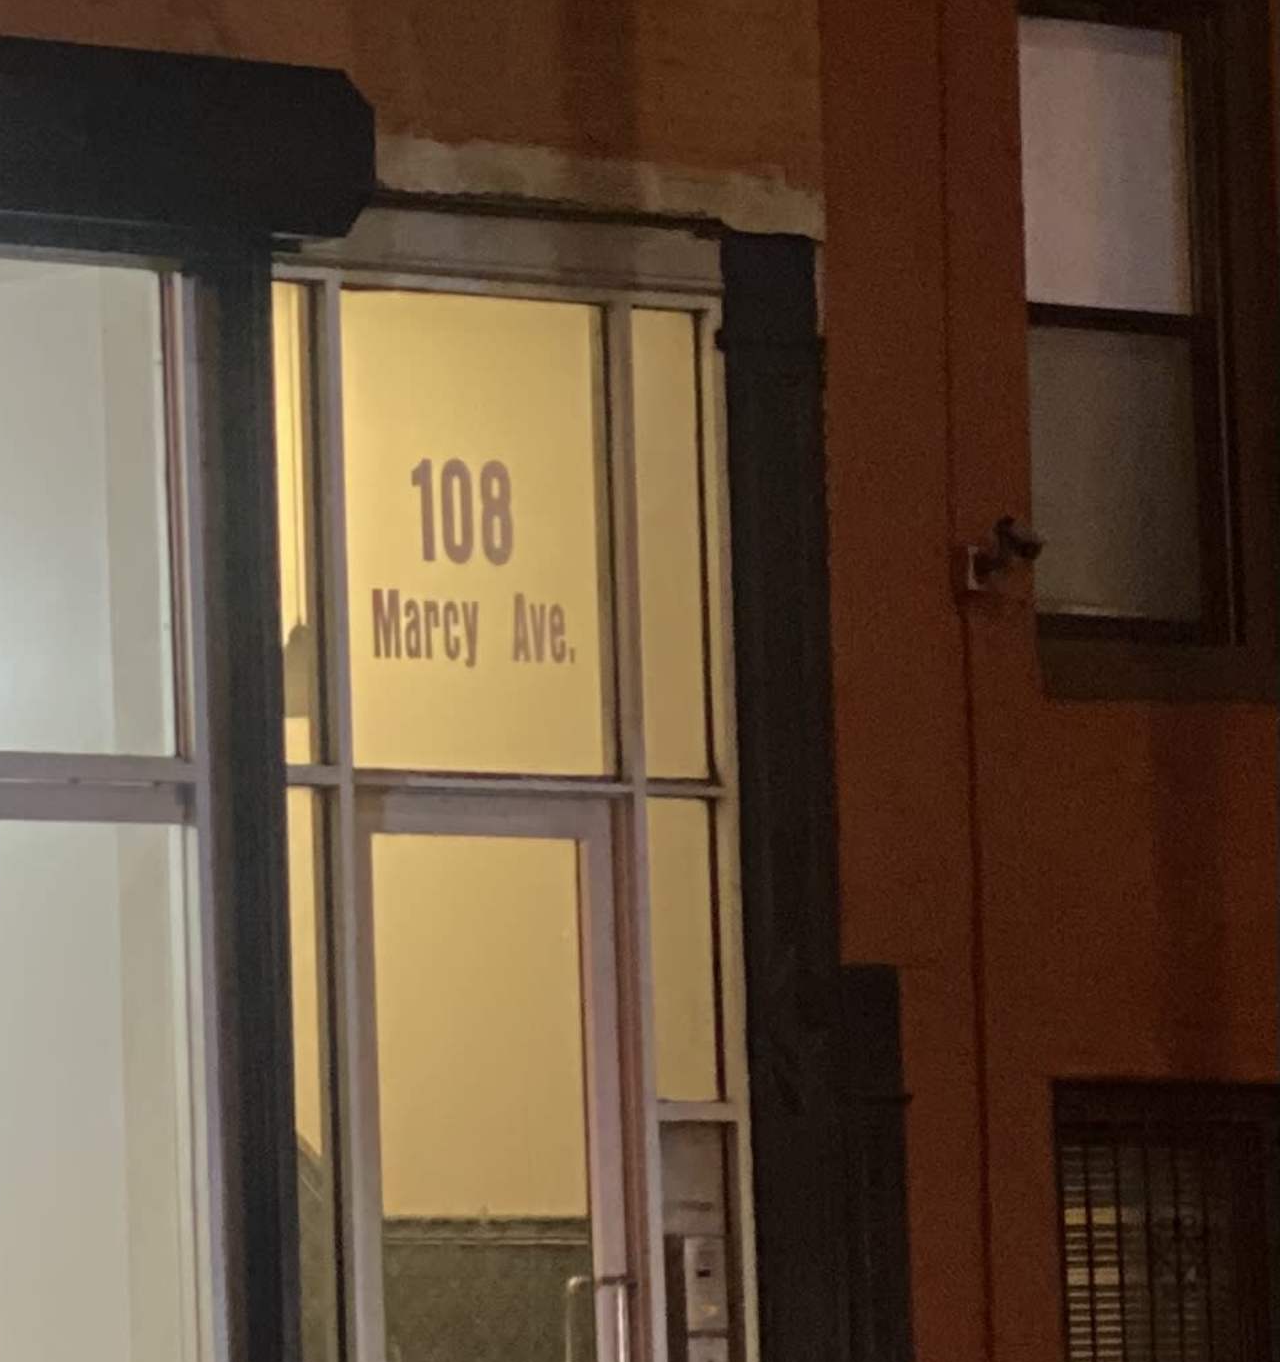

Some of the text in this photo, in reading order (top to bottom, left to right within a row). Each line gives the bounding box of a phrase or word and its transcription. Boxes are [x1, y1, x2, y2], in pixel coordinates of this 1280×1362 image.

[411, 457, 514, 565] 108
[372, 588, 576, 668] Marcy Ave.
